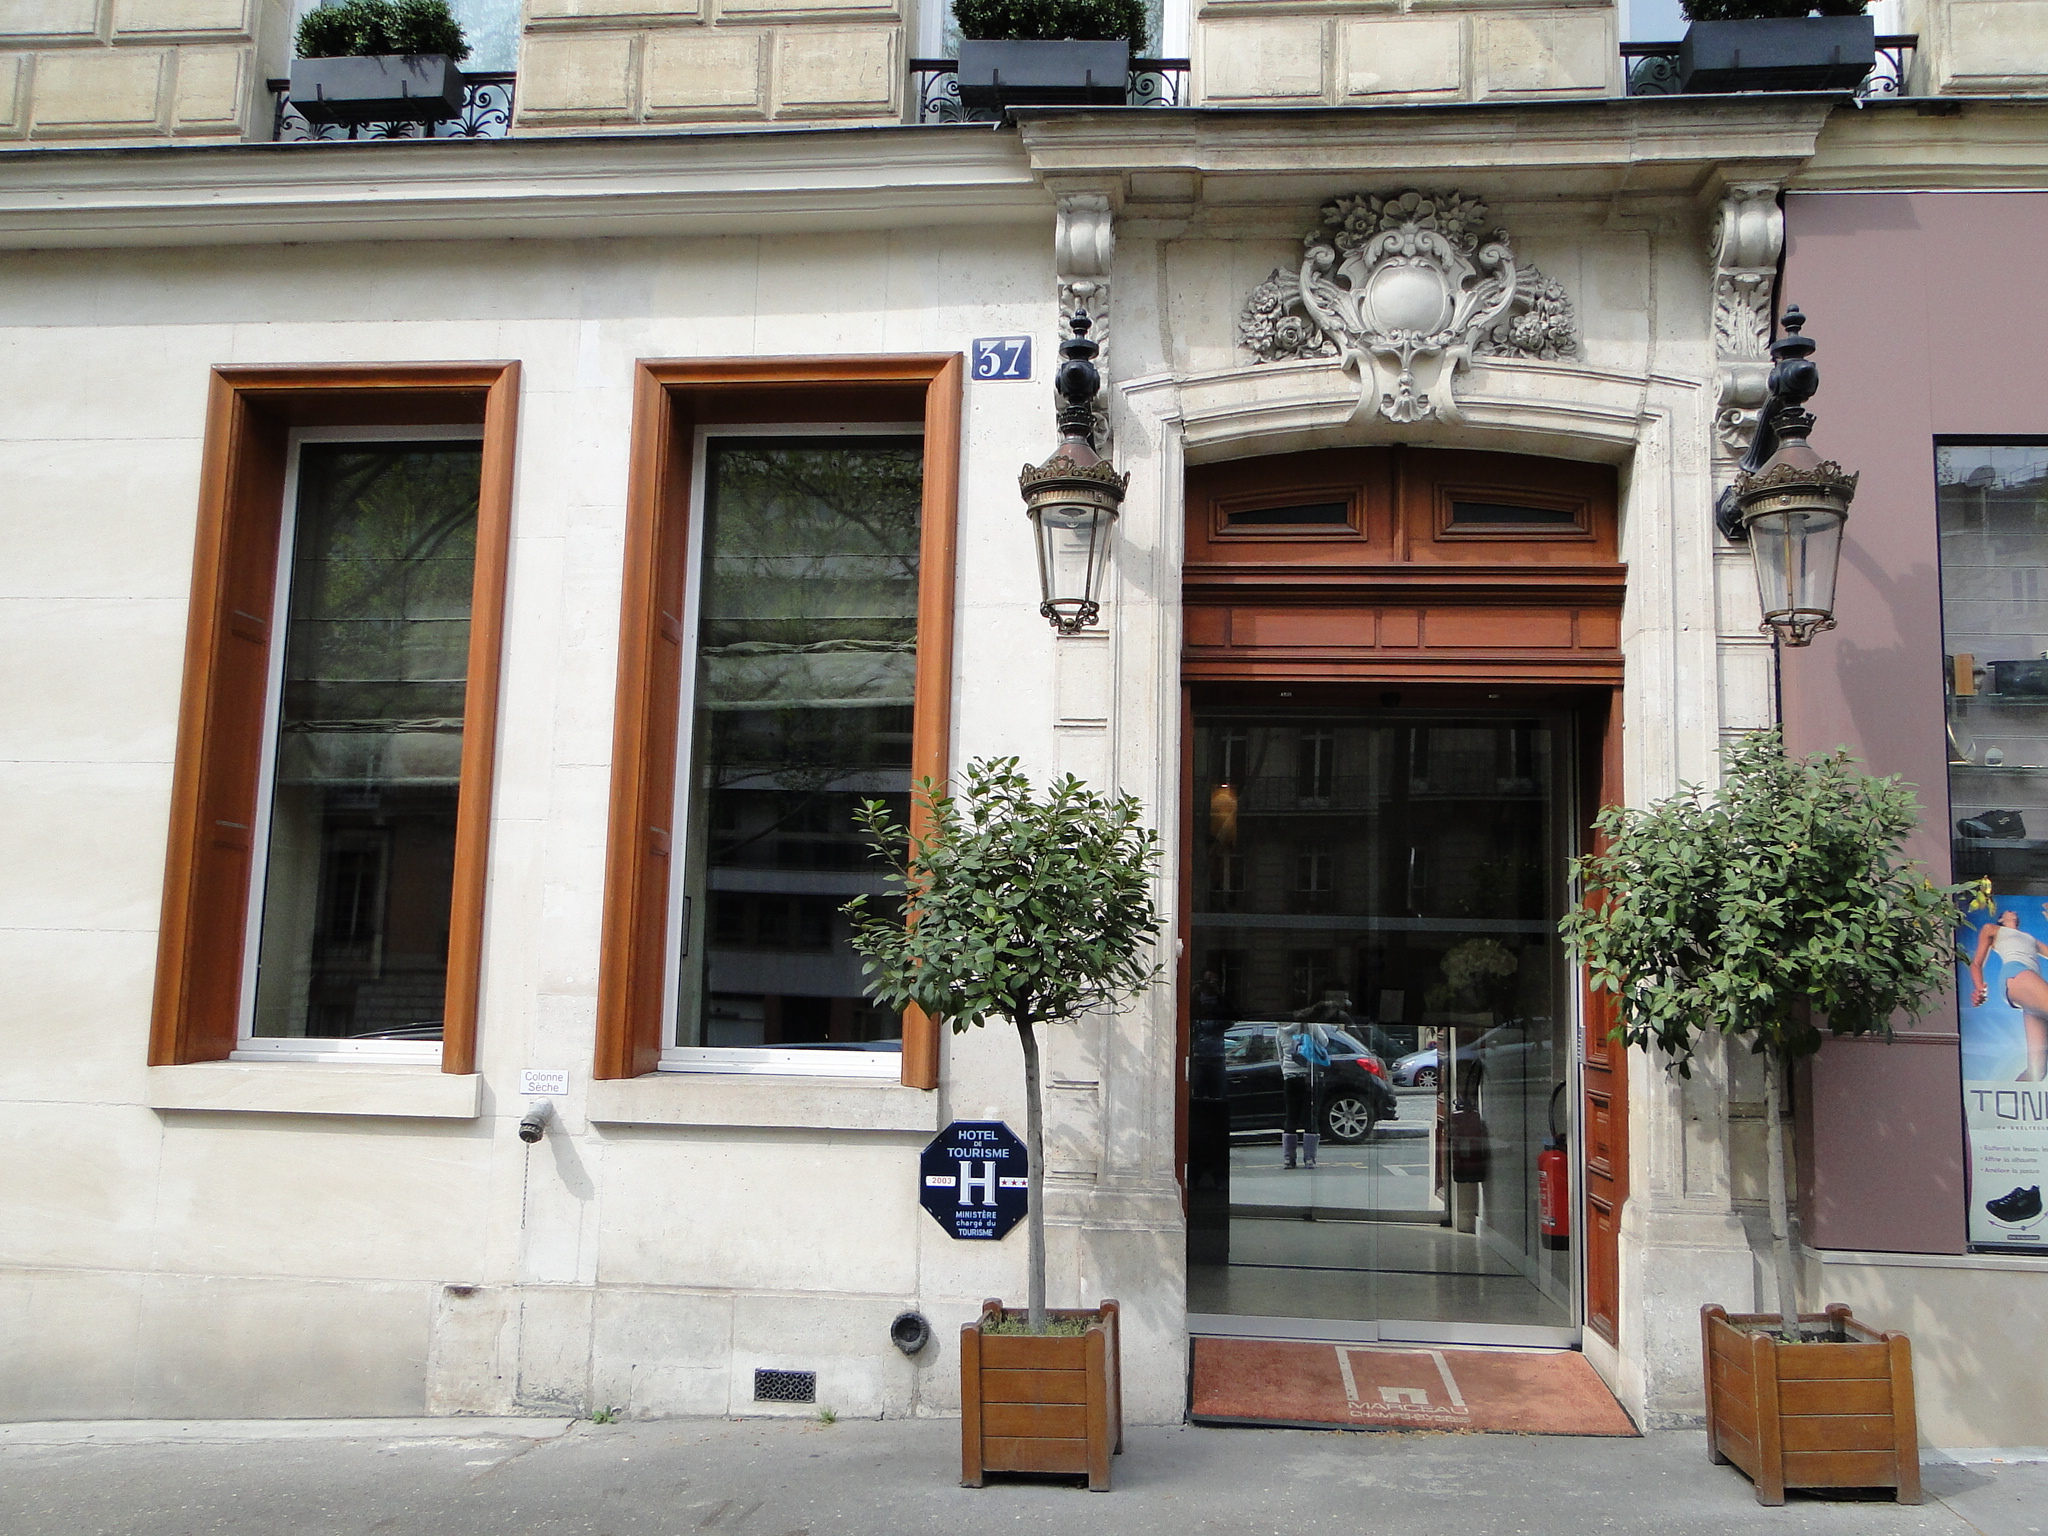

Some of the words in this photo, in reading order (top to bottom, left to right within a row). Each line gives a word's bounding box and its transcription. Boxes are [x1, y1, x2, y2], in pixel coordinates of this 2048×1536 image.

[979, 340, 1026, 377] 37
[525, 1071, 564, 1082] Colonne
[528, 1082, 559, 1092] Sèche
[958, 1130, 999, 1141] HOTEL
[947, 1147, 1010, 1158] TOURISME
[958, 1160, 998, 1206] H
[955, 1209, 997, 1219] MINISTÈRE
[956, 1219, 983, 1228] chargé
[958, 1228, 993, 1237] TOURISME
[1348, 1401, 1469, 1415] MARCEAU
